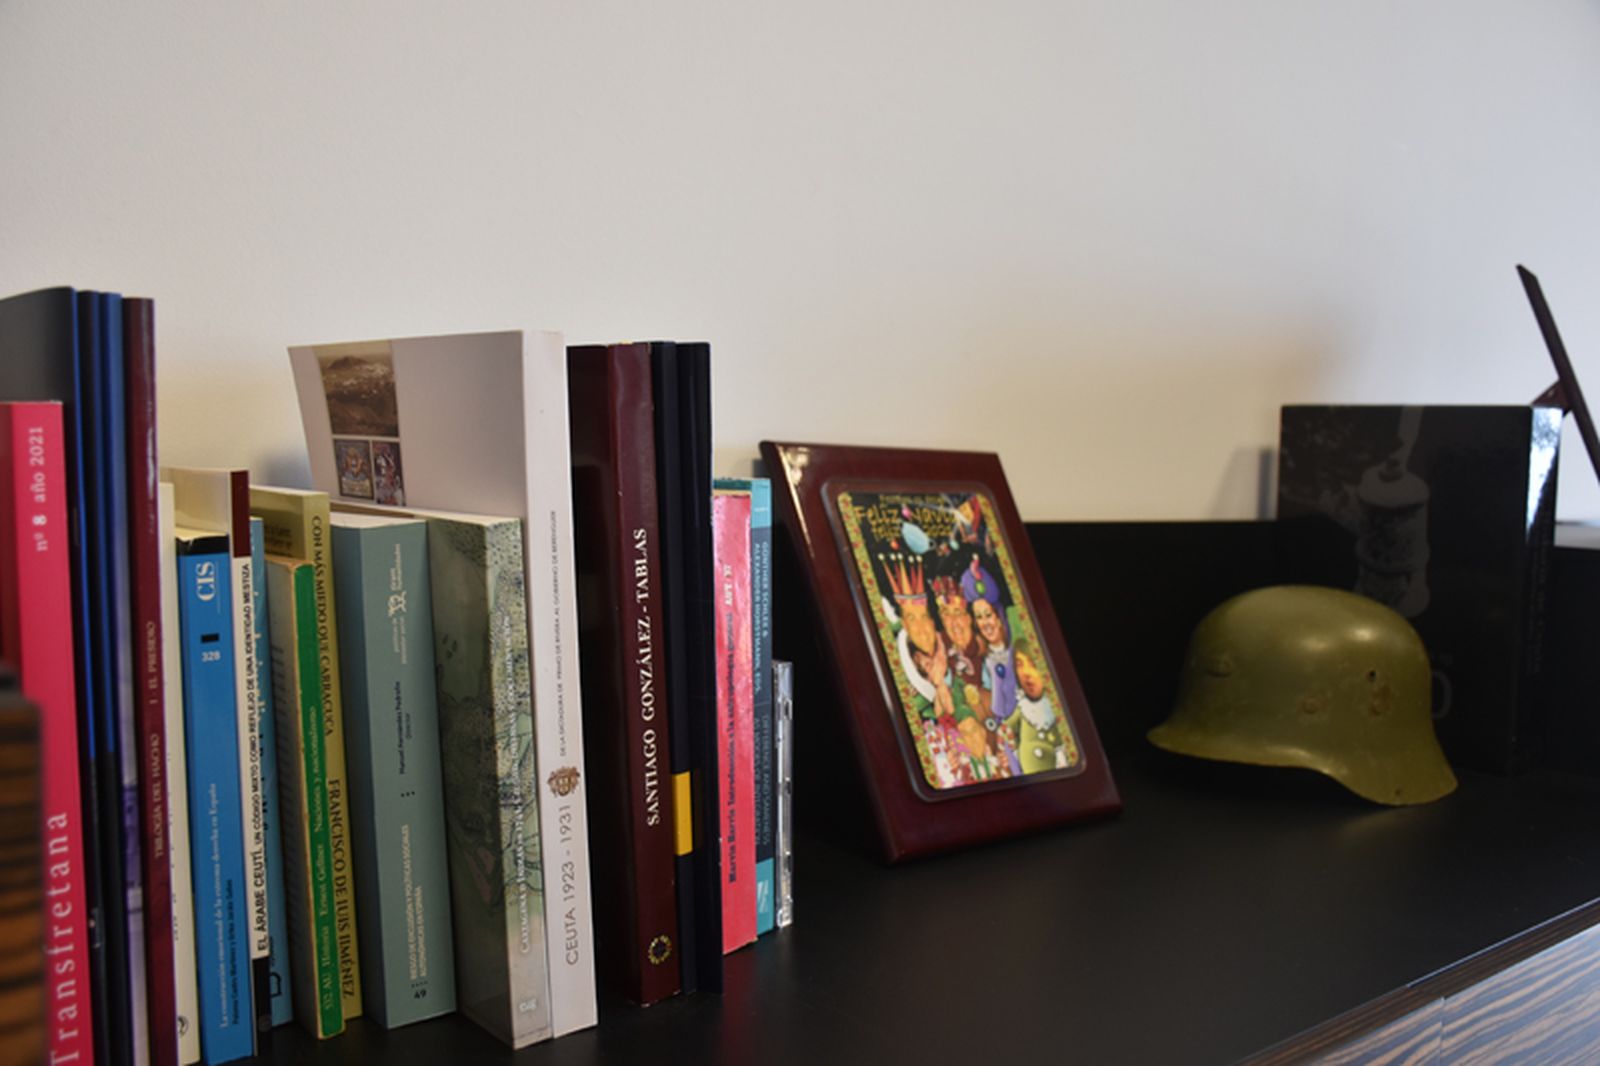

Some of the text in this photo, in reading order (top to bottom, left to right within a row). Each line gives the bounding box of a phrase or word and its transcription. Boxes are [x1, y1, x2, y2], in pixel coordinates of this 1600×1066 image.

[29, 426, 44, 465] 2021
[30, 472, 46, 502] año
[32, 514, 47, 525] 8
[197, 561, 217, 601] CIS
[242, 563, 250, 603] MESTIZA
[632, 527, 650, 602] TABLAS
[244, 605, 253, 653] IDENTIDAD
[311, 515, 332, 736] CON MÁS MIEDO QUE CARRACUCA
[246, 657, 254, 675] UNA
[247, 677, 253, 689] DE
[634, 615, 655, 721] GONZÁLEZ
[248, 691, 256, 732] REFLEJO
[641, 729, 660, 826] SANTIAGO
[252, 794, 262, 829] CÓDIGO
[559, 805, 571, 842] 1931
[255, 832, 262, 844] UN
[326, 778, 344, 872] FRANCISCO
[335, 875, 346, 900] DE
[562, 860, 574, 900] 1923
[254, 889, 266, 932] ÁRABE
[520, 893, 531, 952] CARTAGENA
[47, 812, 80, 1066] Transfretana
[258, 936, 266, 950] EL
[565, 907, 578, 964] CEUTA
[414, 988, 428, 999] 49
